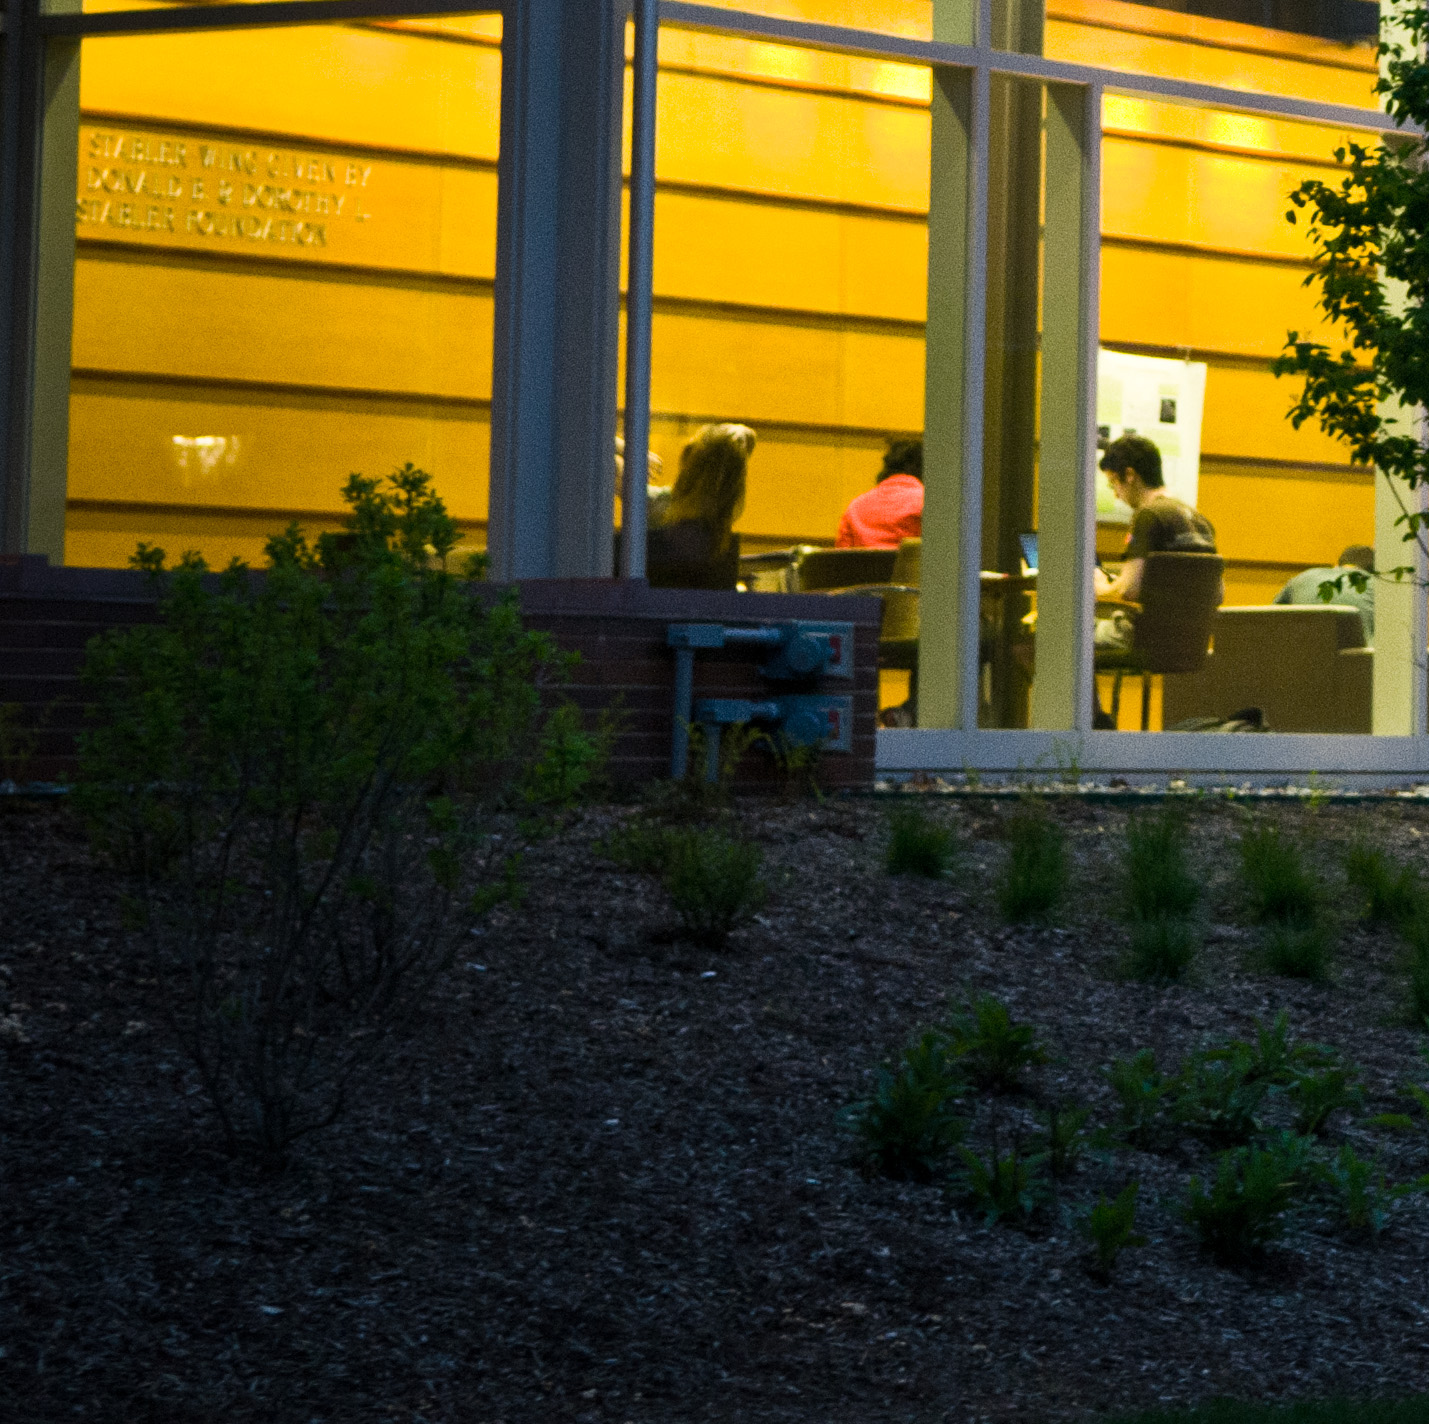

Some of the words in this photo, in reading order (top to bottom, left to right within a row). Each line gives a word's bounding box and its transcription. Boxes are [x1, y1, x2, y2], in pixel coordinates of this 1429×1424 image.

[90, 133, 187, 168] STABLER
[199, 145, 258, 175] WING
[266, 152, 336, 183] GIVEN
[344, 162, 372, 187] BY
[86, 167, 184, 201] DONALD
[242, 182, 345, 216] DOROTHY
[76, 198, 175, 233] STABLER
[184, 210, 327, 248] FOUNDATION
